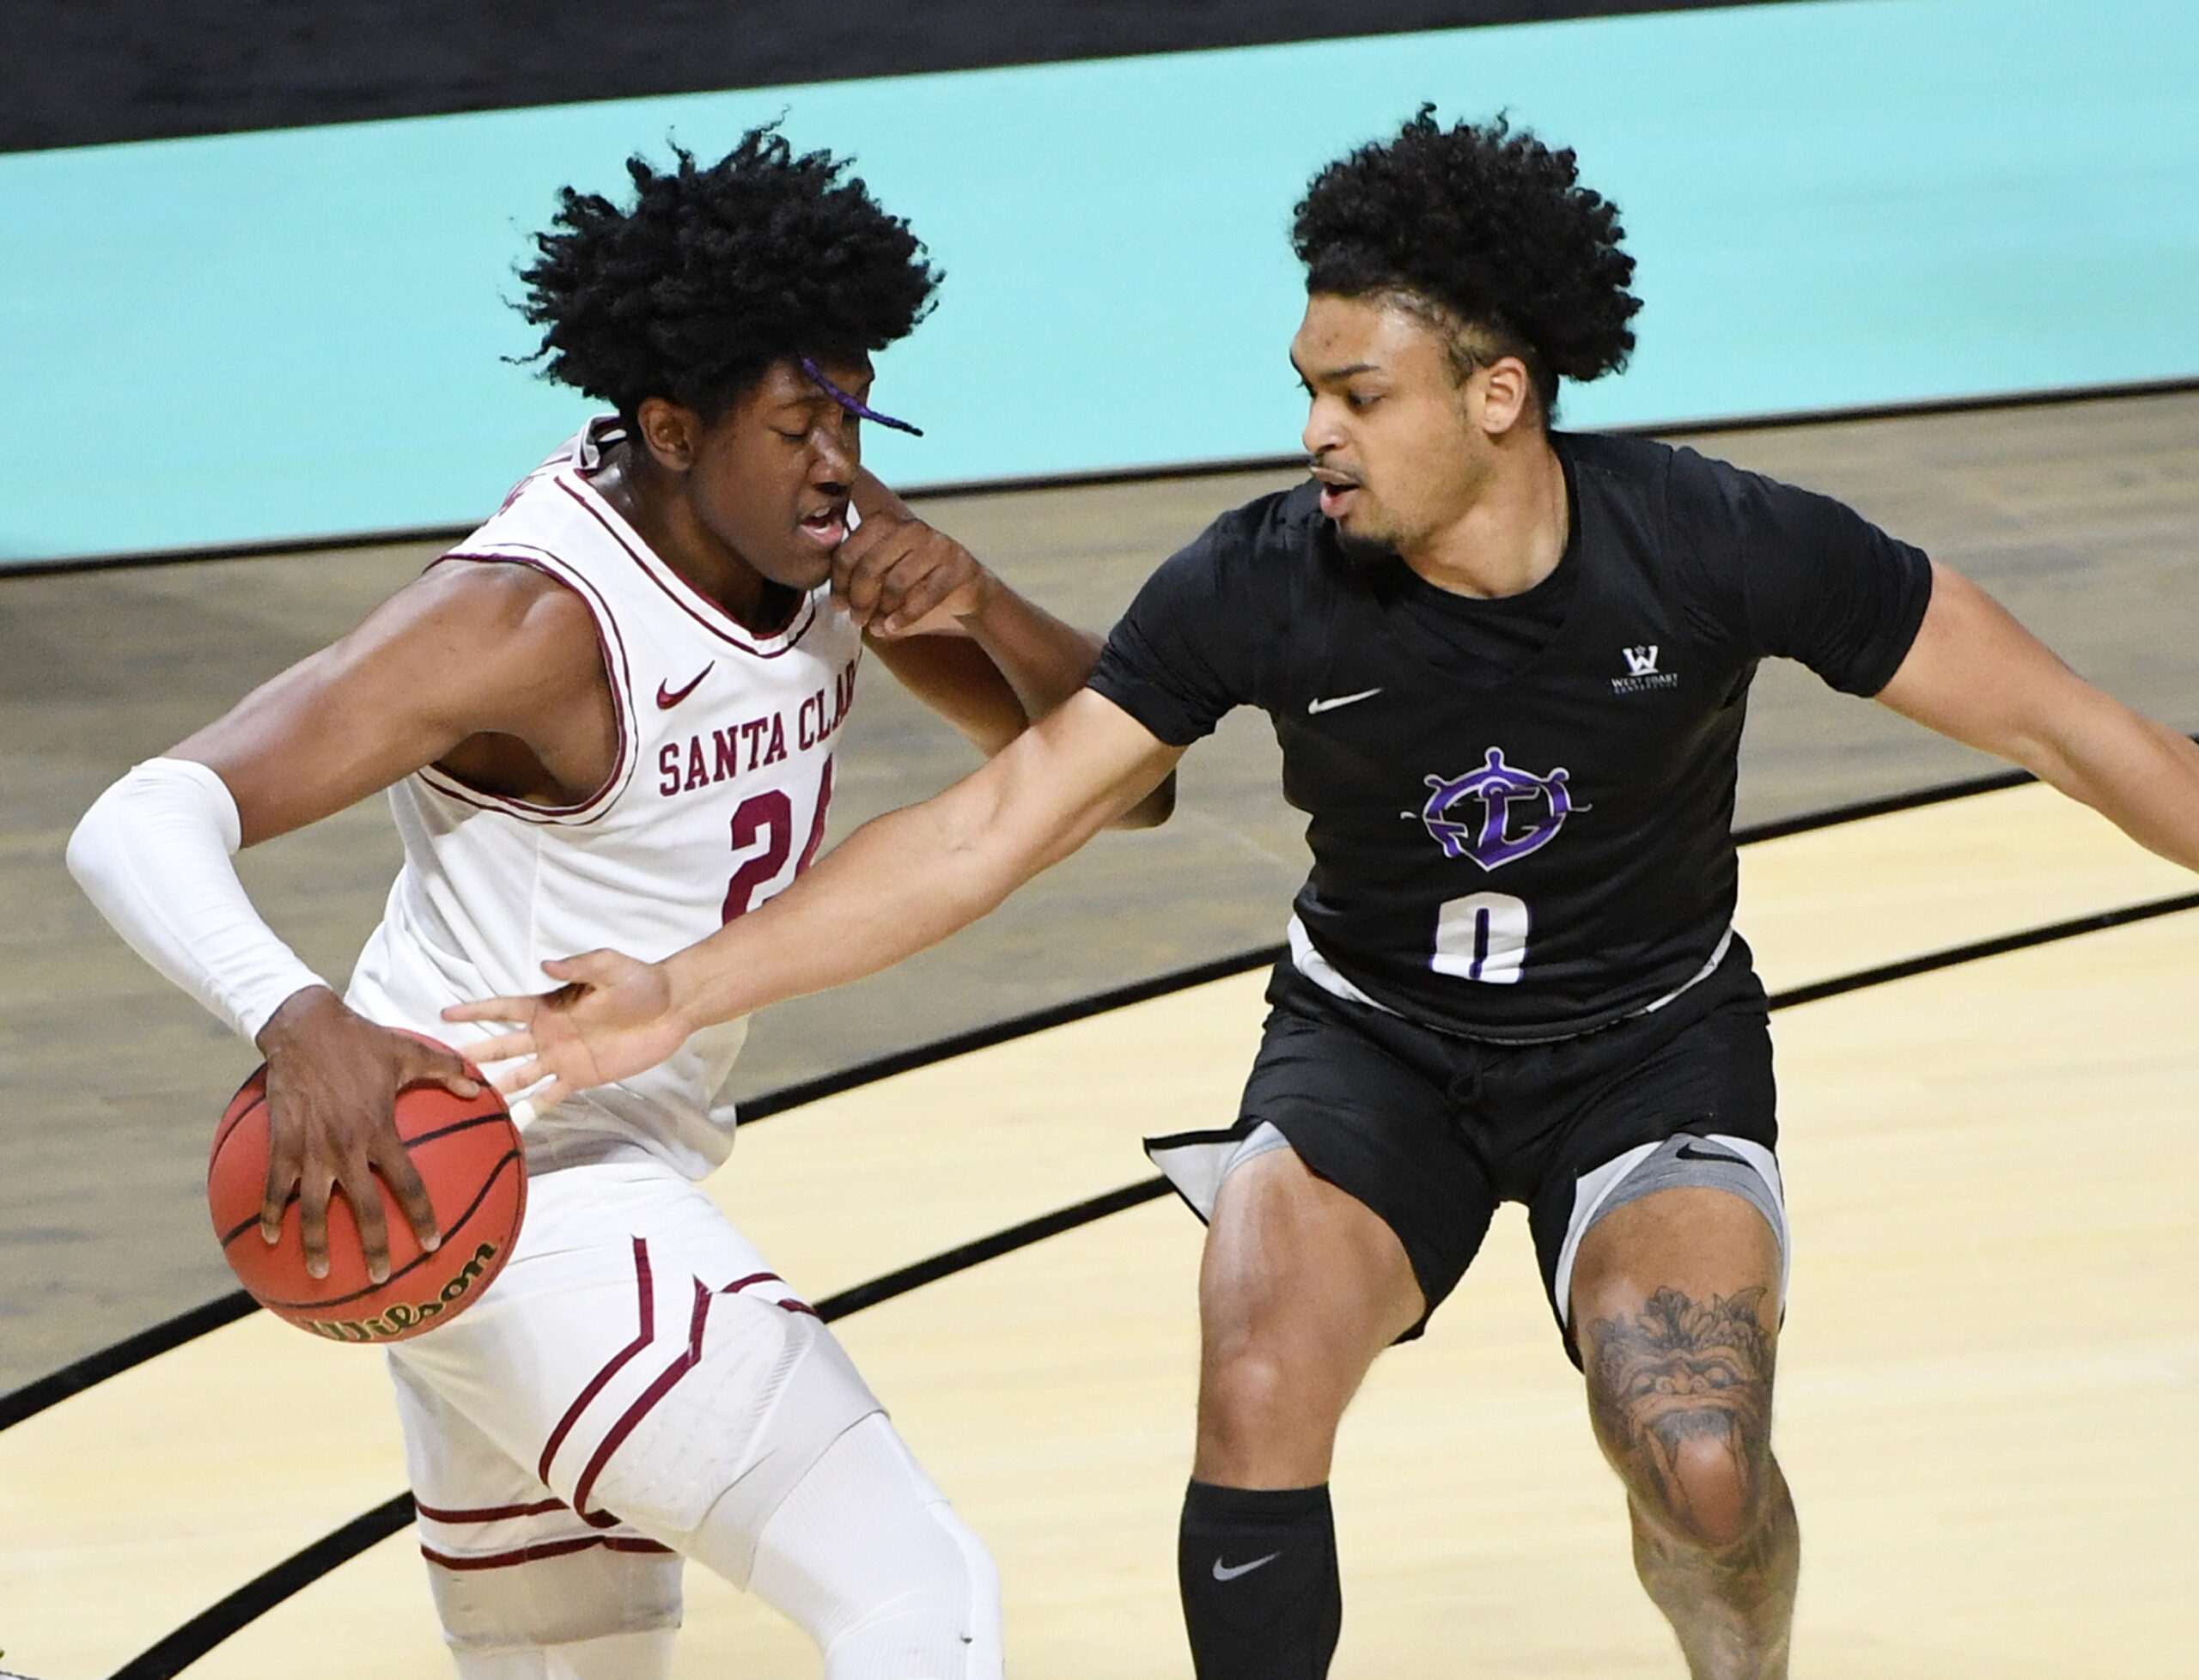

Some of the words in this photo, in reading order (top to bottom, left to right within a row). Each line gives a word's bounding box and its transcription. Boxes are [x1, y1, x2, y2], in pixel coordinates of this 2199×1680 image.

[659, 711, 787, 797] SANTA
[1429, 892, 1529, 984] 0
[301, 1242, 498, 1340] Wilson
